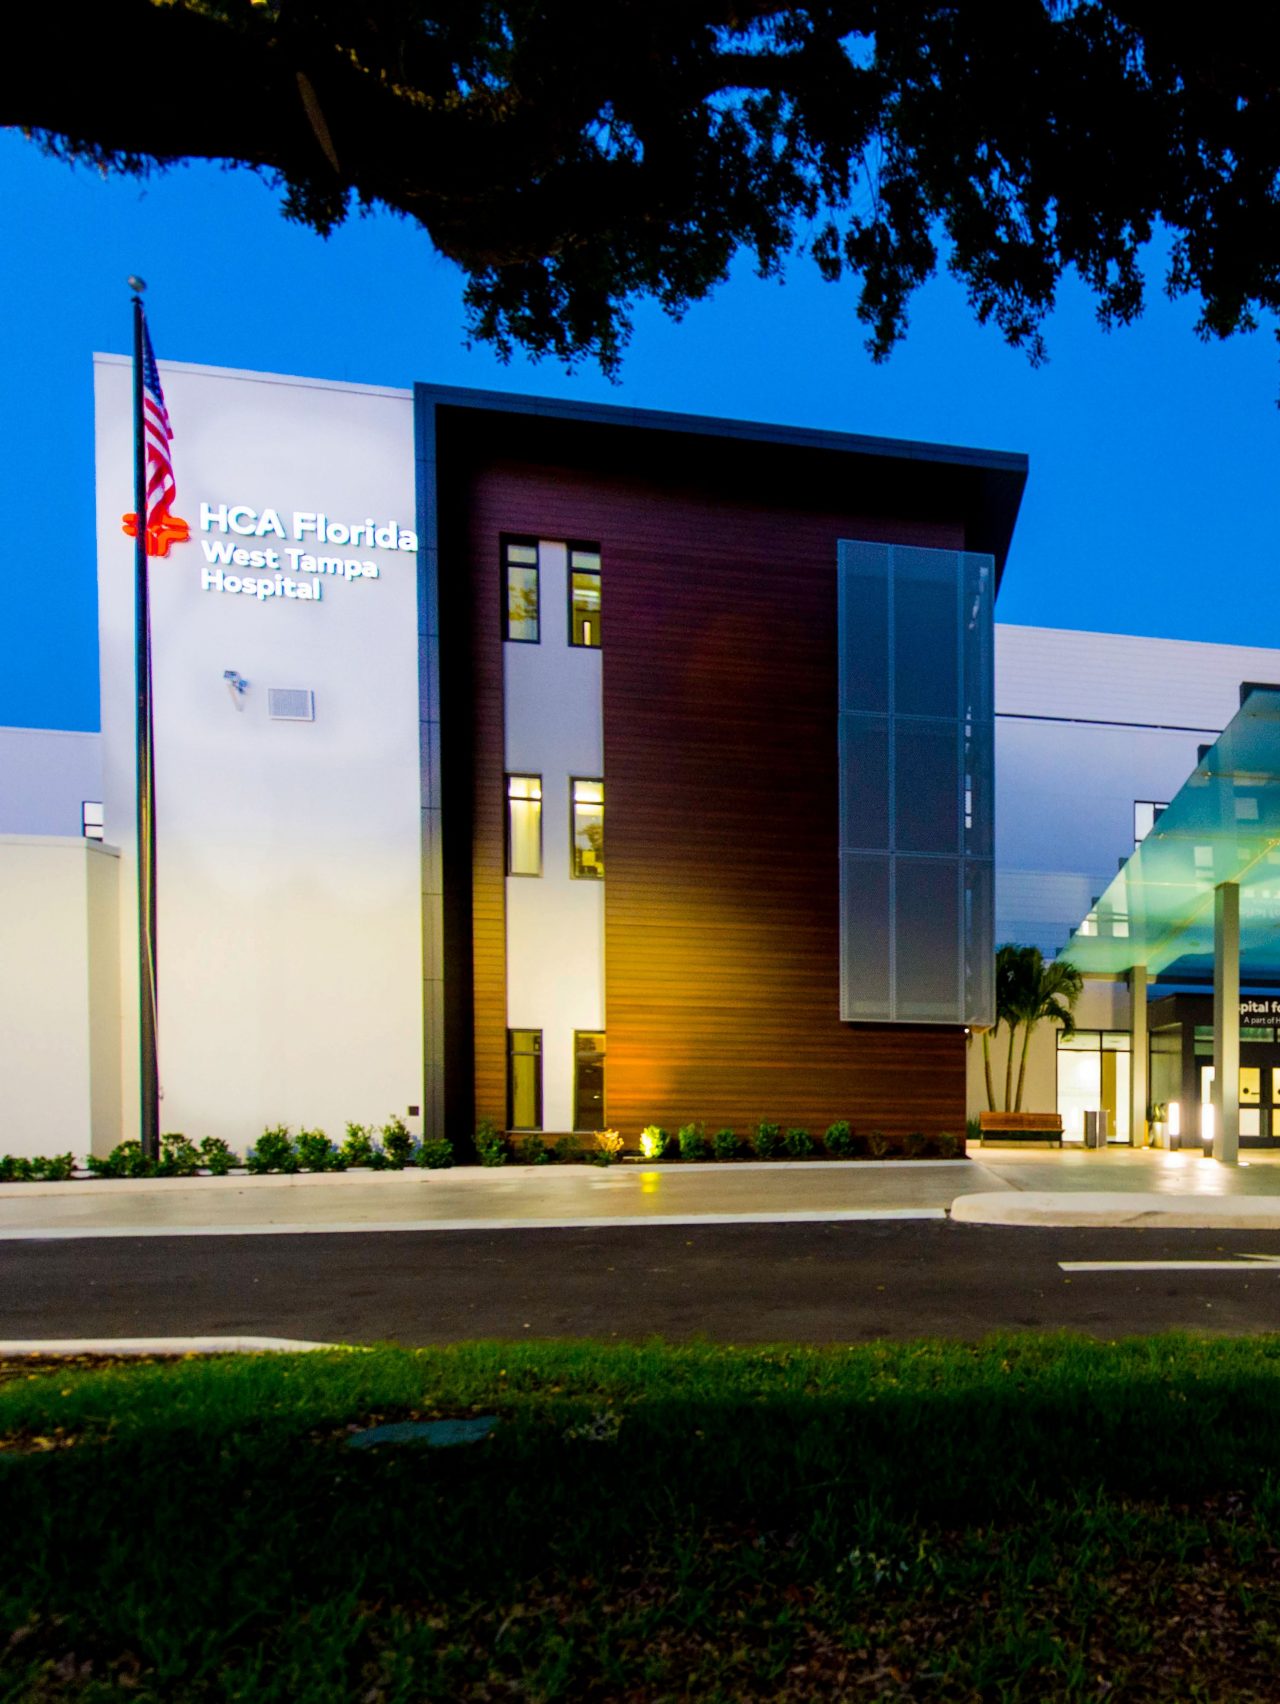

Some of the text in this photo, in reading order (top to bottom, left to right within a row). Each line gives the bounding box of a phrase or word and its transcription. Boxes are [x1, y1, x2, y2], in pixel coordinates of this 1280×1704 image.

[200, 502, 418, 552] HCA Florida
[201, 540, 379, 582] West Tampa
[201, 568, 322, 601] Hospital
[1239, 1000, 1269, 1015] pital
[1243, 1016, 1250, 1024] A
[1251, 1017, 1266, 1025] part
[1267, 1016, 1275, 1024] of
